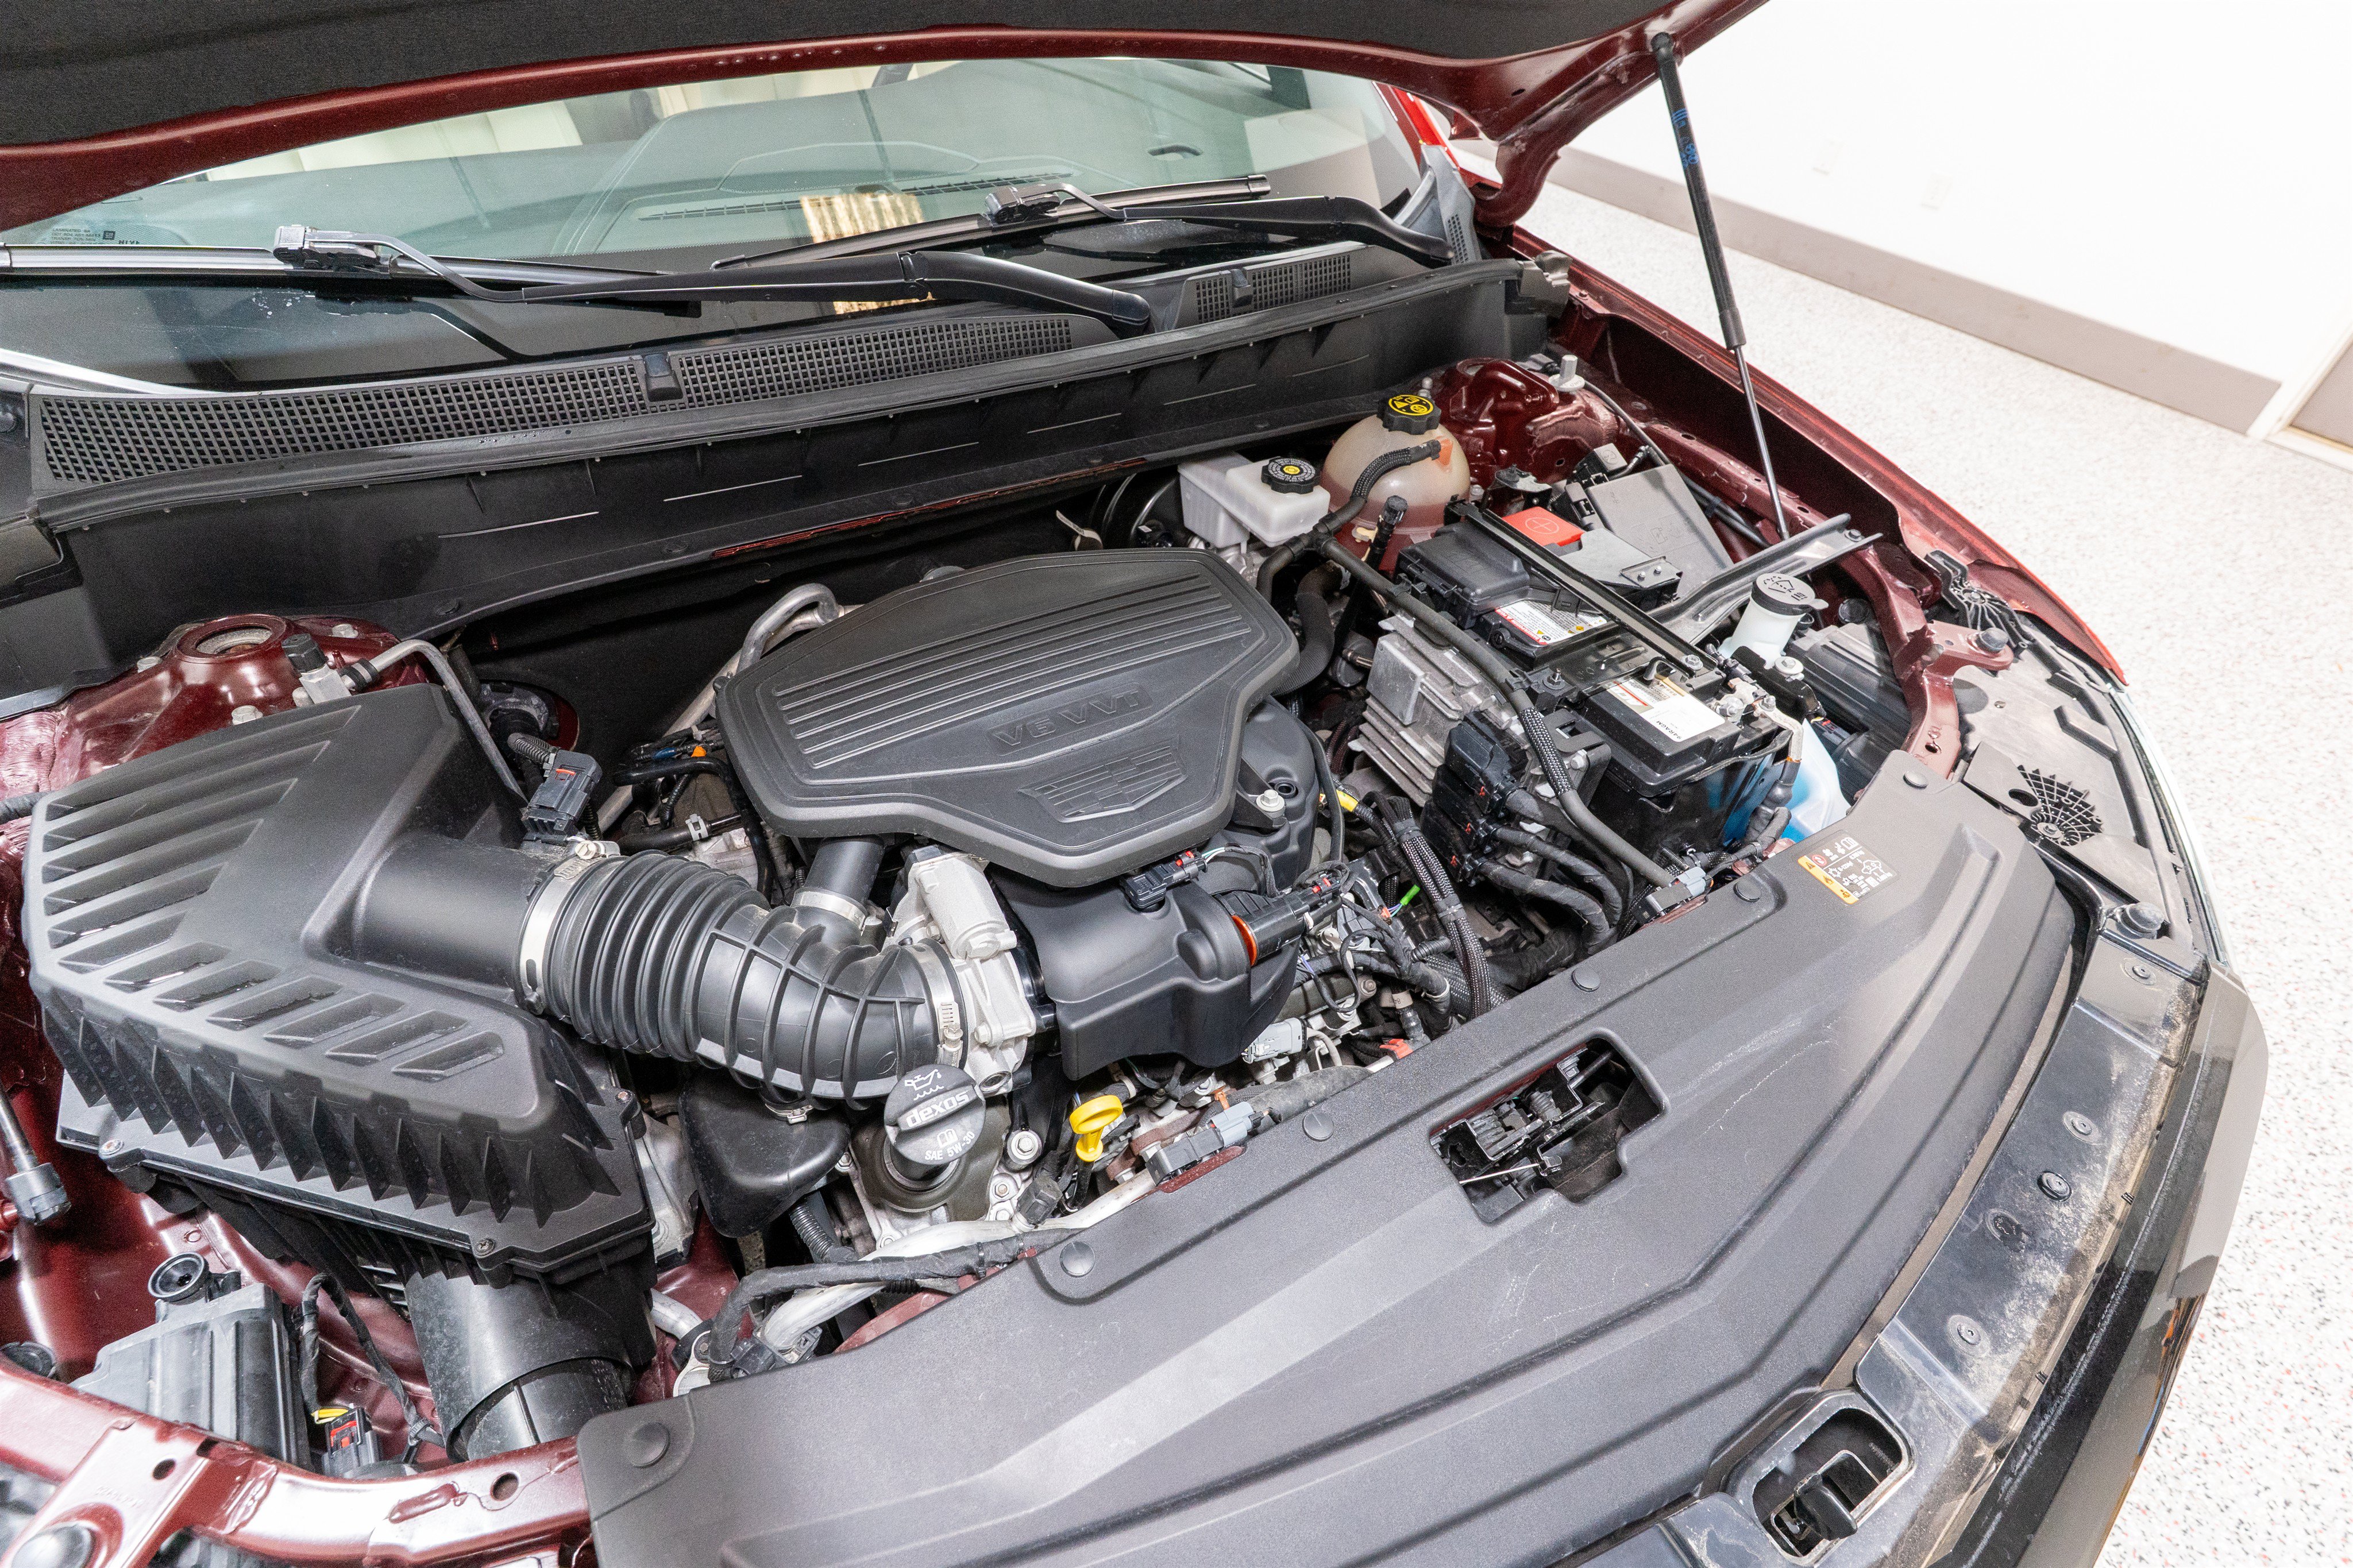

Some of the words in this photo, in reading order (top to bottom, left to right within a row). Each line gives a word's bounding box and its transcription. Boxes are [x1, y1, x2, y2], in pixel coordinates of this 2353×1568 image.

[992, 717, 1056, 746] V6
[1058, 689, 1140, 724] VVT
[1656, 720, 1683, 740] 94RAGM
[906, 1090, 970, 1127] dexos
[924, 1150, 943, 1161] SAE
[947, 1130, 975, 1157] 5W-30
